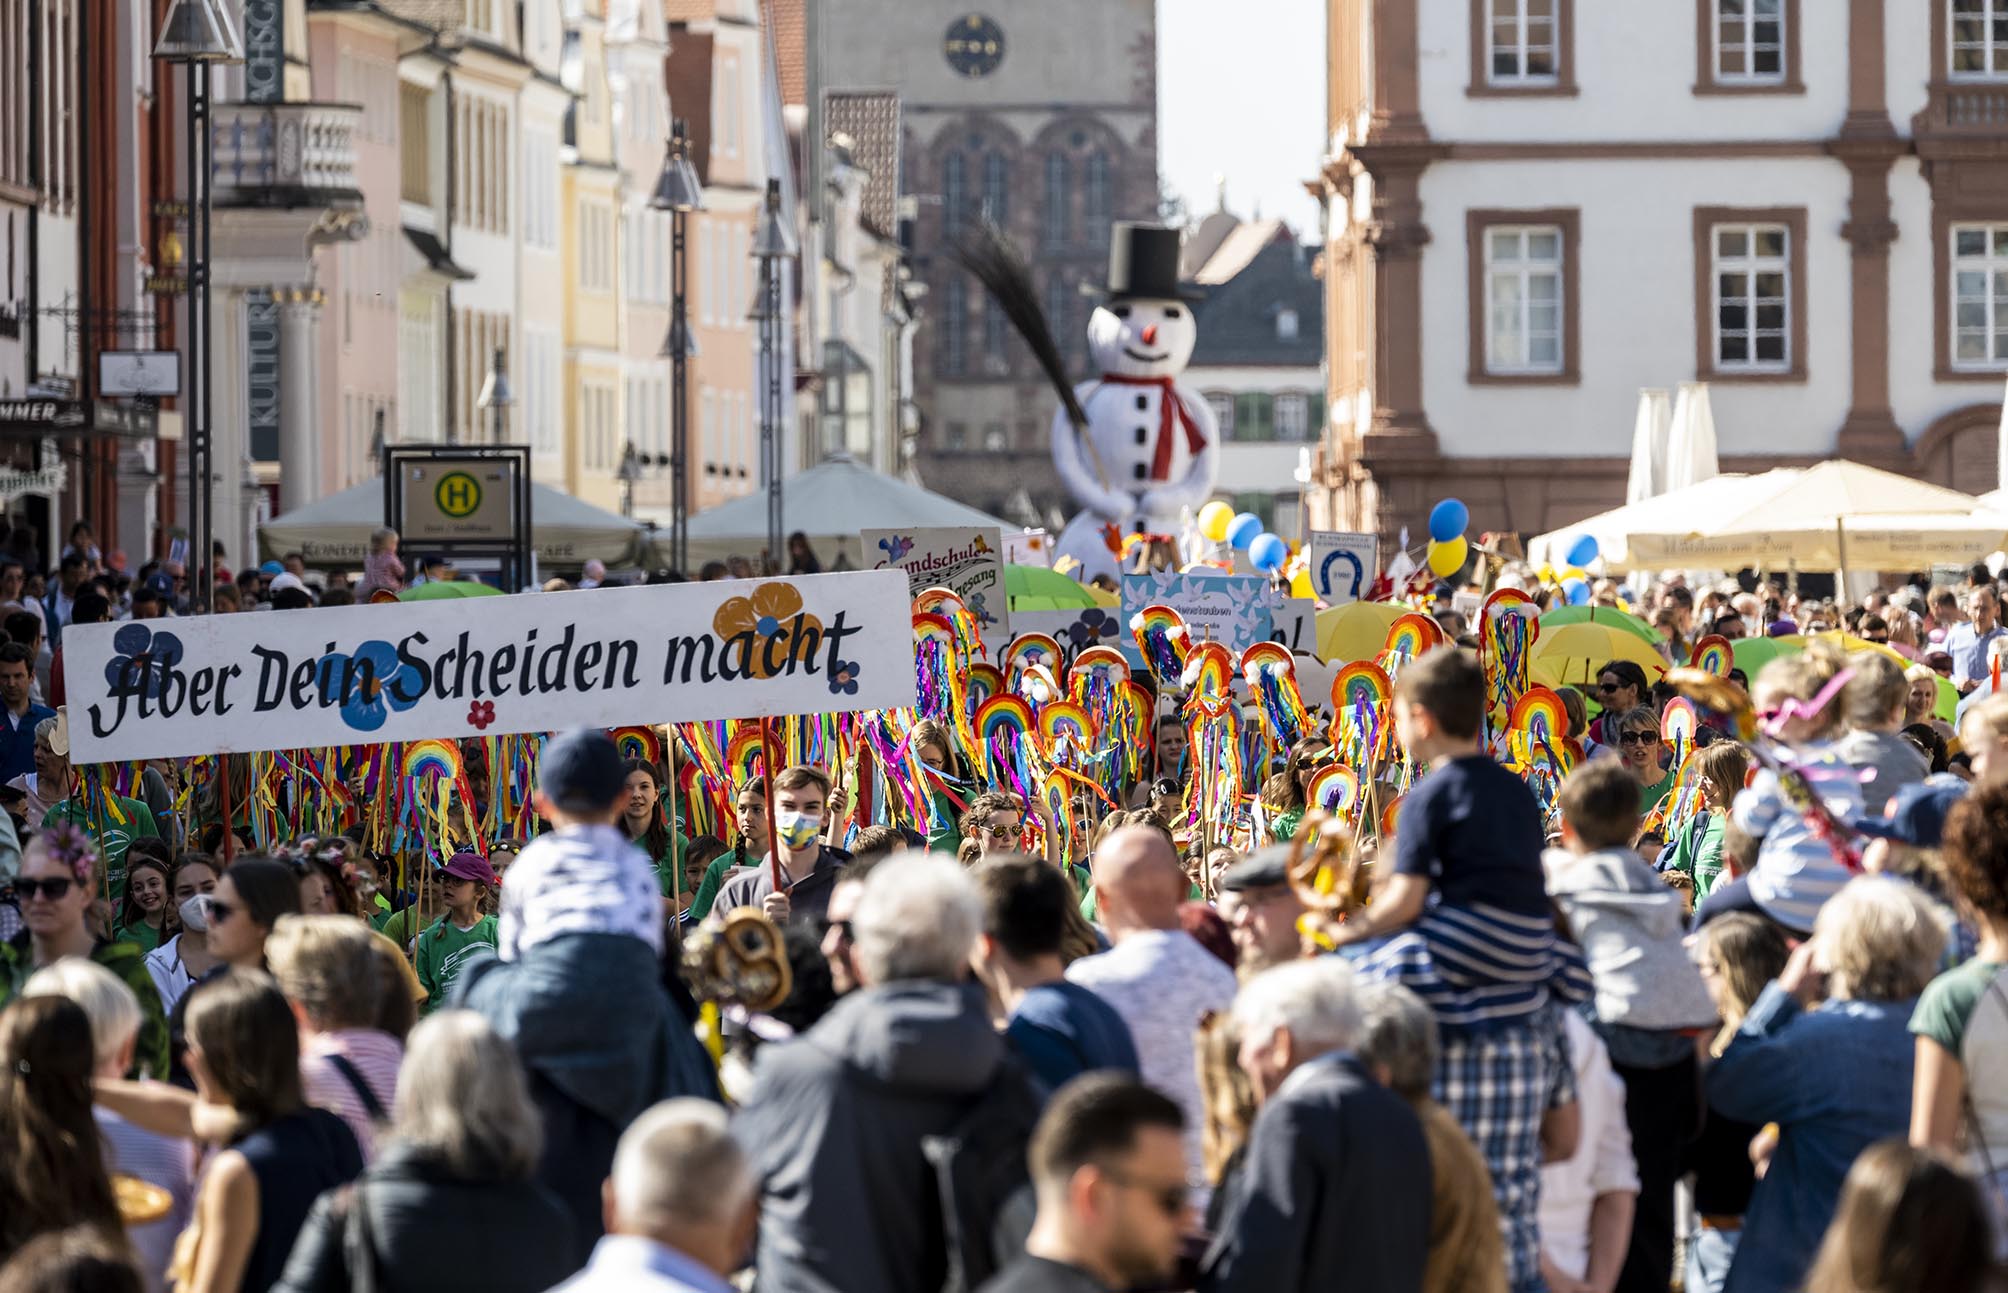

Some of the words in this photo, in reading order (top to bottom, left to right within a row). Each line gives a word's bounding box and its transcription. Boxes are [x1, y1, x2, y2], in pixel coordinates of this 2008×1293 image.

[874, 542, 981, 575] undschule
[88, 651, 243, 738] Aber
[251, 641, 382, 712] Dein
[390, 623, 641, 701] Scheiden
[663, 610, 864, 686] macht
